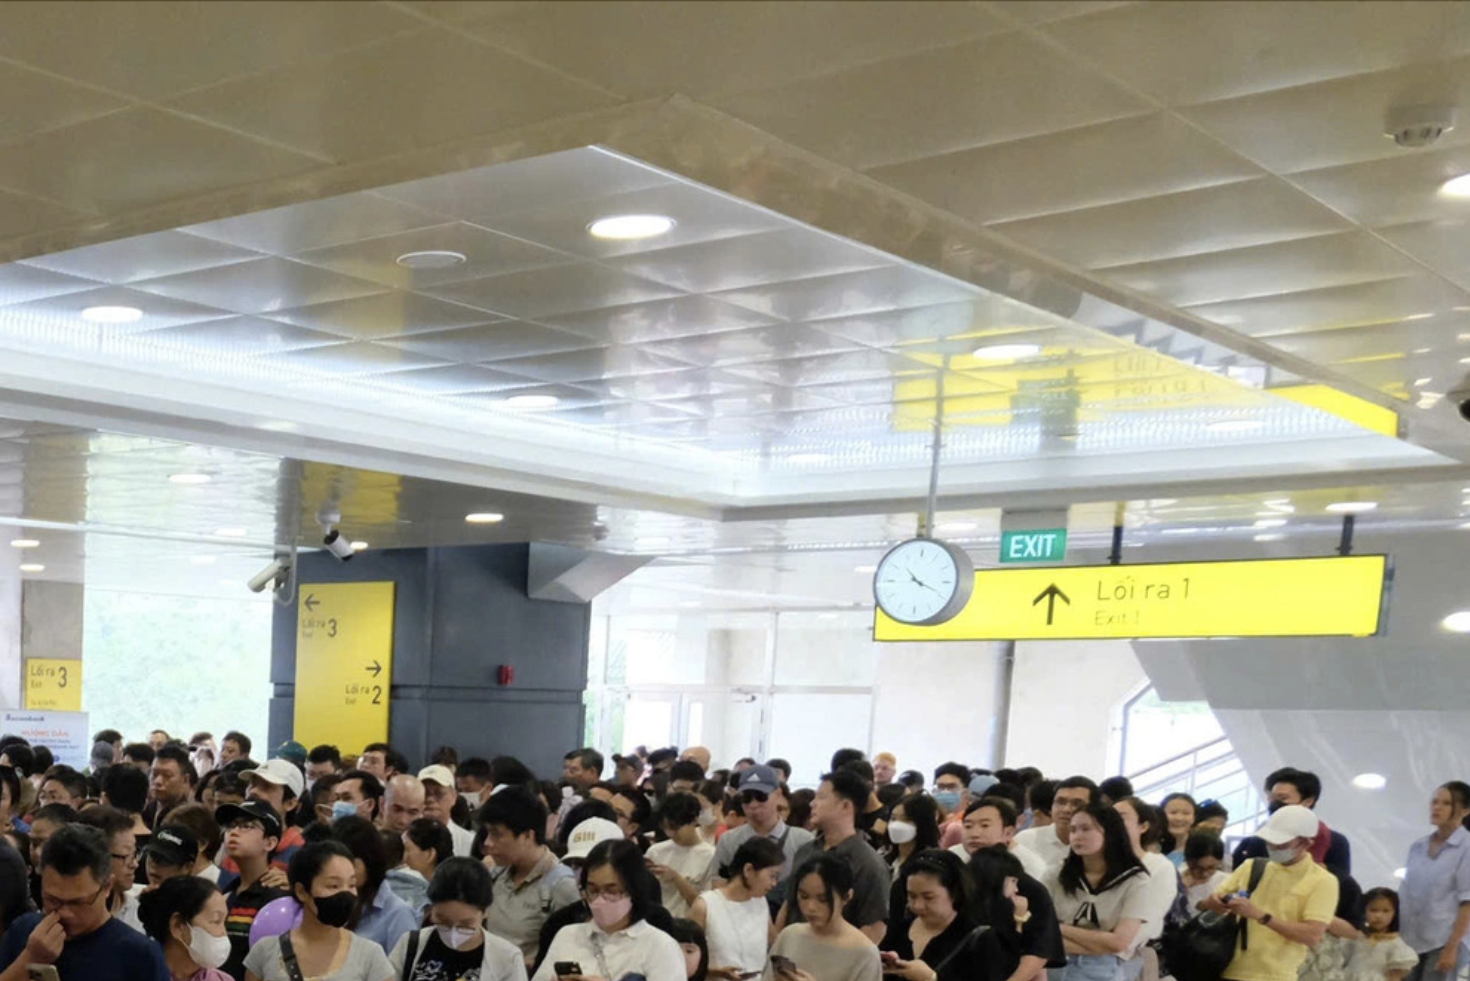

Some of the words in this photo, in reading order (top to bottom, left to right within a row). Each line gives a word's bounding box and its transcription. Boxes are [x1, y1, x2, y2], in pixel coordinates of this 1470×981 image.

[1009, 533, 1056, 558] EXIT
[1096, 575, 1136, 601] Lối
[1144, 583, 1171, 600] ra
[1182, 577, 1190, 600] 1
[327, 618, 337, 638] 3
[1094, 609, 1127, 626] Exit
[58, 666, 68, 688] 3
[371, 685, 382, 705] 2
